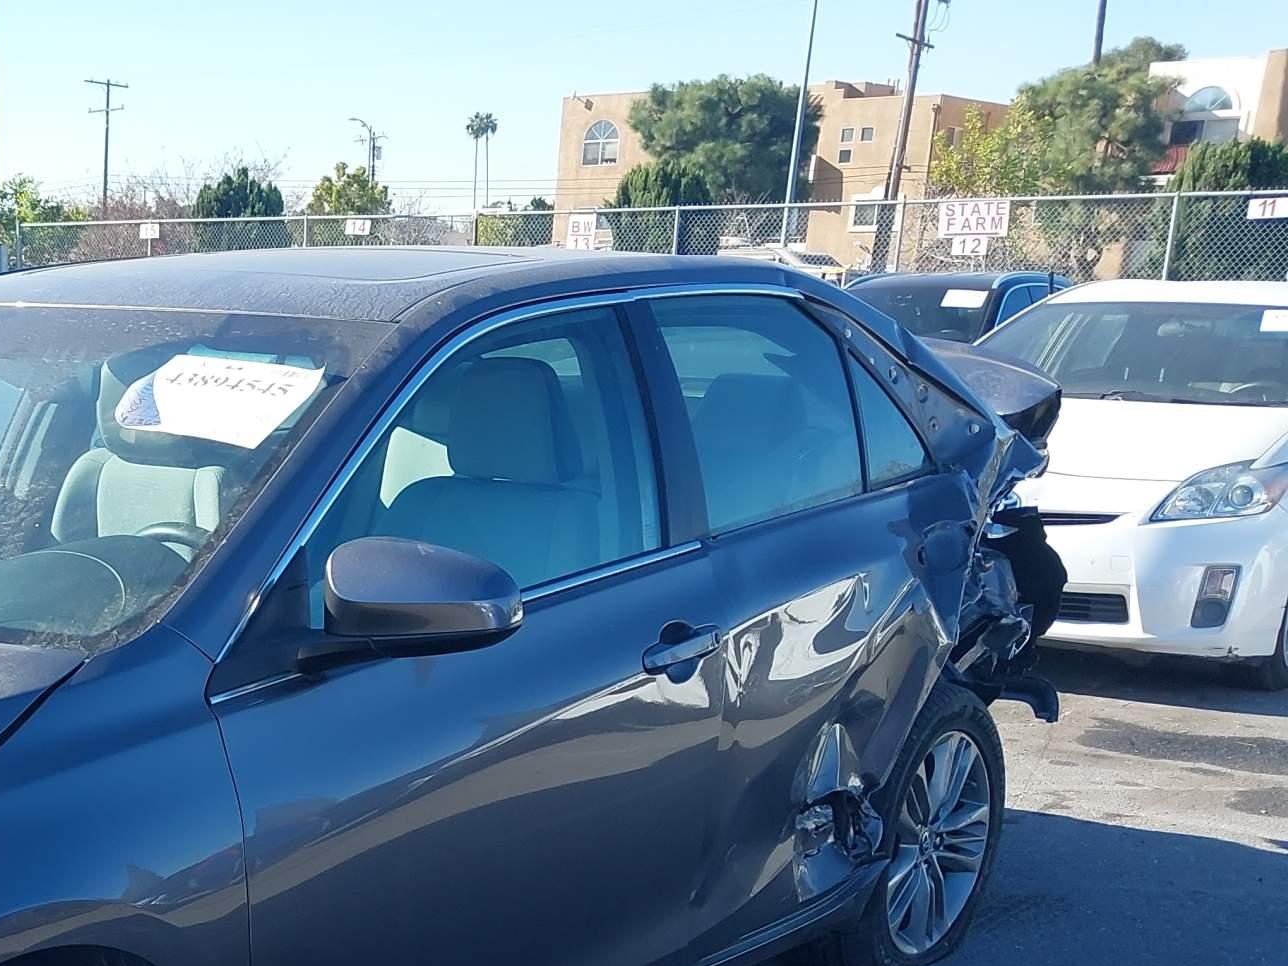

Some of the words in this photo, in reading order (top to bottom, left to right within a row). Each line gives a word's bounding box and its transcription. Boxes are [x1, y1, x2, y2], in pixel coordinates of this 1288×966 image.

[945, 201, 1007, 217] STATE
[1258, 199, 1277, 217] 11
[351, 220, 366, 234] 14
[946, 216, 1003, 231] FARM
[959, 237, 982, 254] 12
